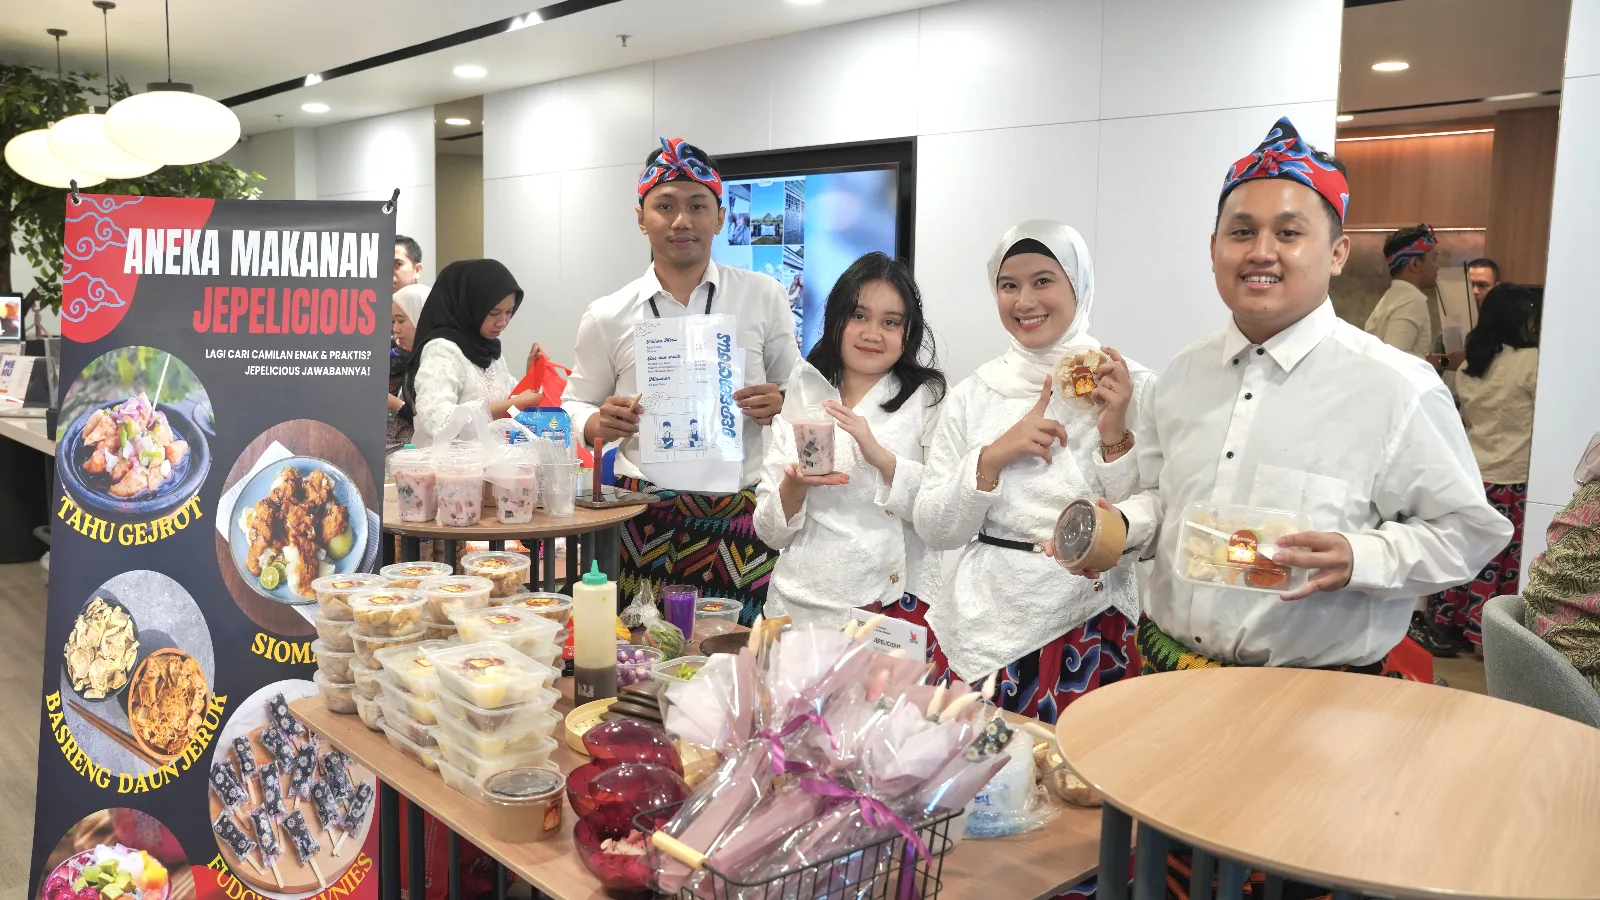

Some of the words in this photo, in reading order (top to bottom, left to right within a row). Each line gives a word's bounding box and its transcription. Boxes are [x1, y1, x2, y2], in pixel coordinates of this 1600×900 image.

[123, 228, 220, 276] ANEKA
[230, 230, 379, 278] MAKANAN
[192, 286, 377, 335] JEPELICIOUS
[4, 360, 16, 369] ME
[205, 349, 226, 359] LAGI
[228, 349, 250, 359] CARI
[251, 350, 294, 360] CAMILAN
[294, 350, 319, 360] ENAK
[321, 350, 328, 360] &
[329, 350, 372, 361] PRAKTIS?
[1, 369, 13, 377] NU
[245, 366, 301, 376] JEPELICIOUS
[301, 366, 371, 376] JAWABANNYA!
[57, 495, 116, 544] TAHU
[118, 496, 203, 546] GEJROT
[46, 690, 112, 789] BASRENG
[117, 759, 180, 794] DAUN
[180, 691, 228, 771] JERUK
